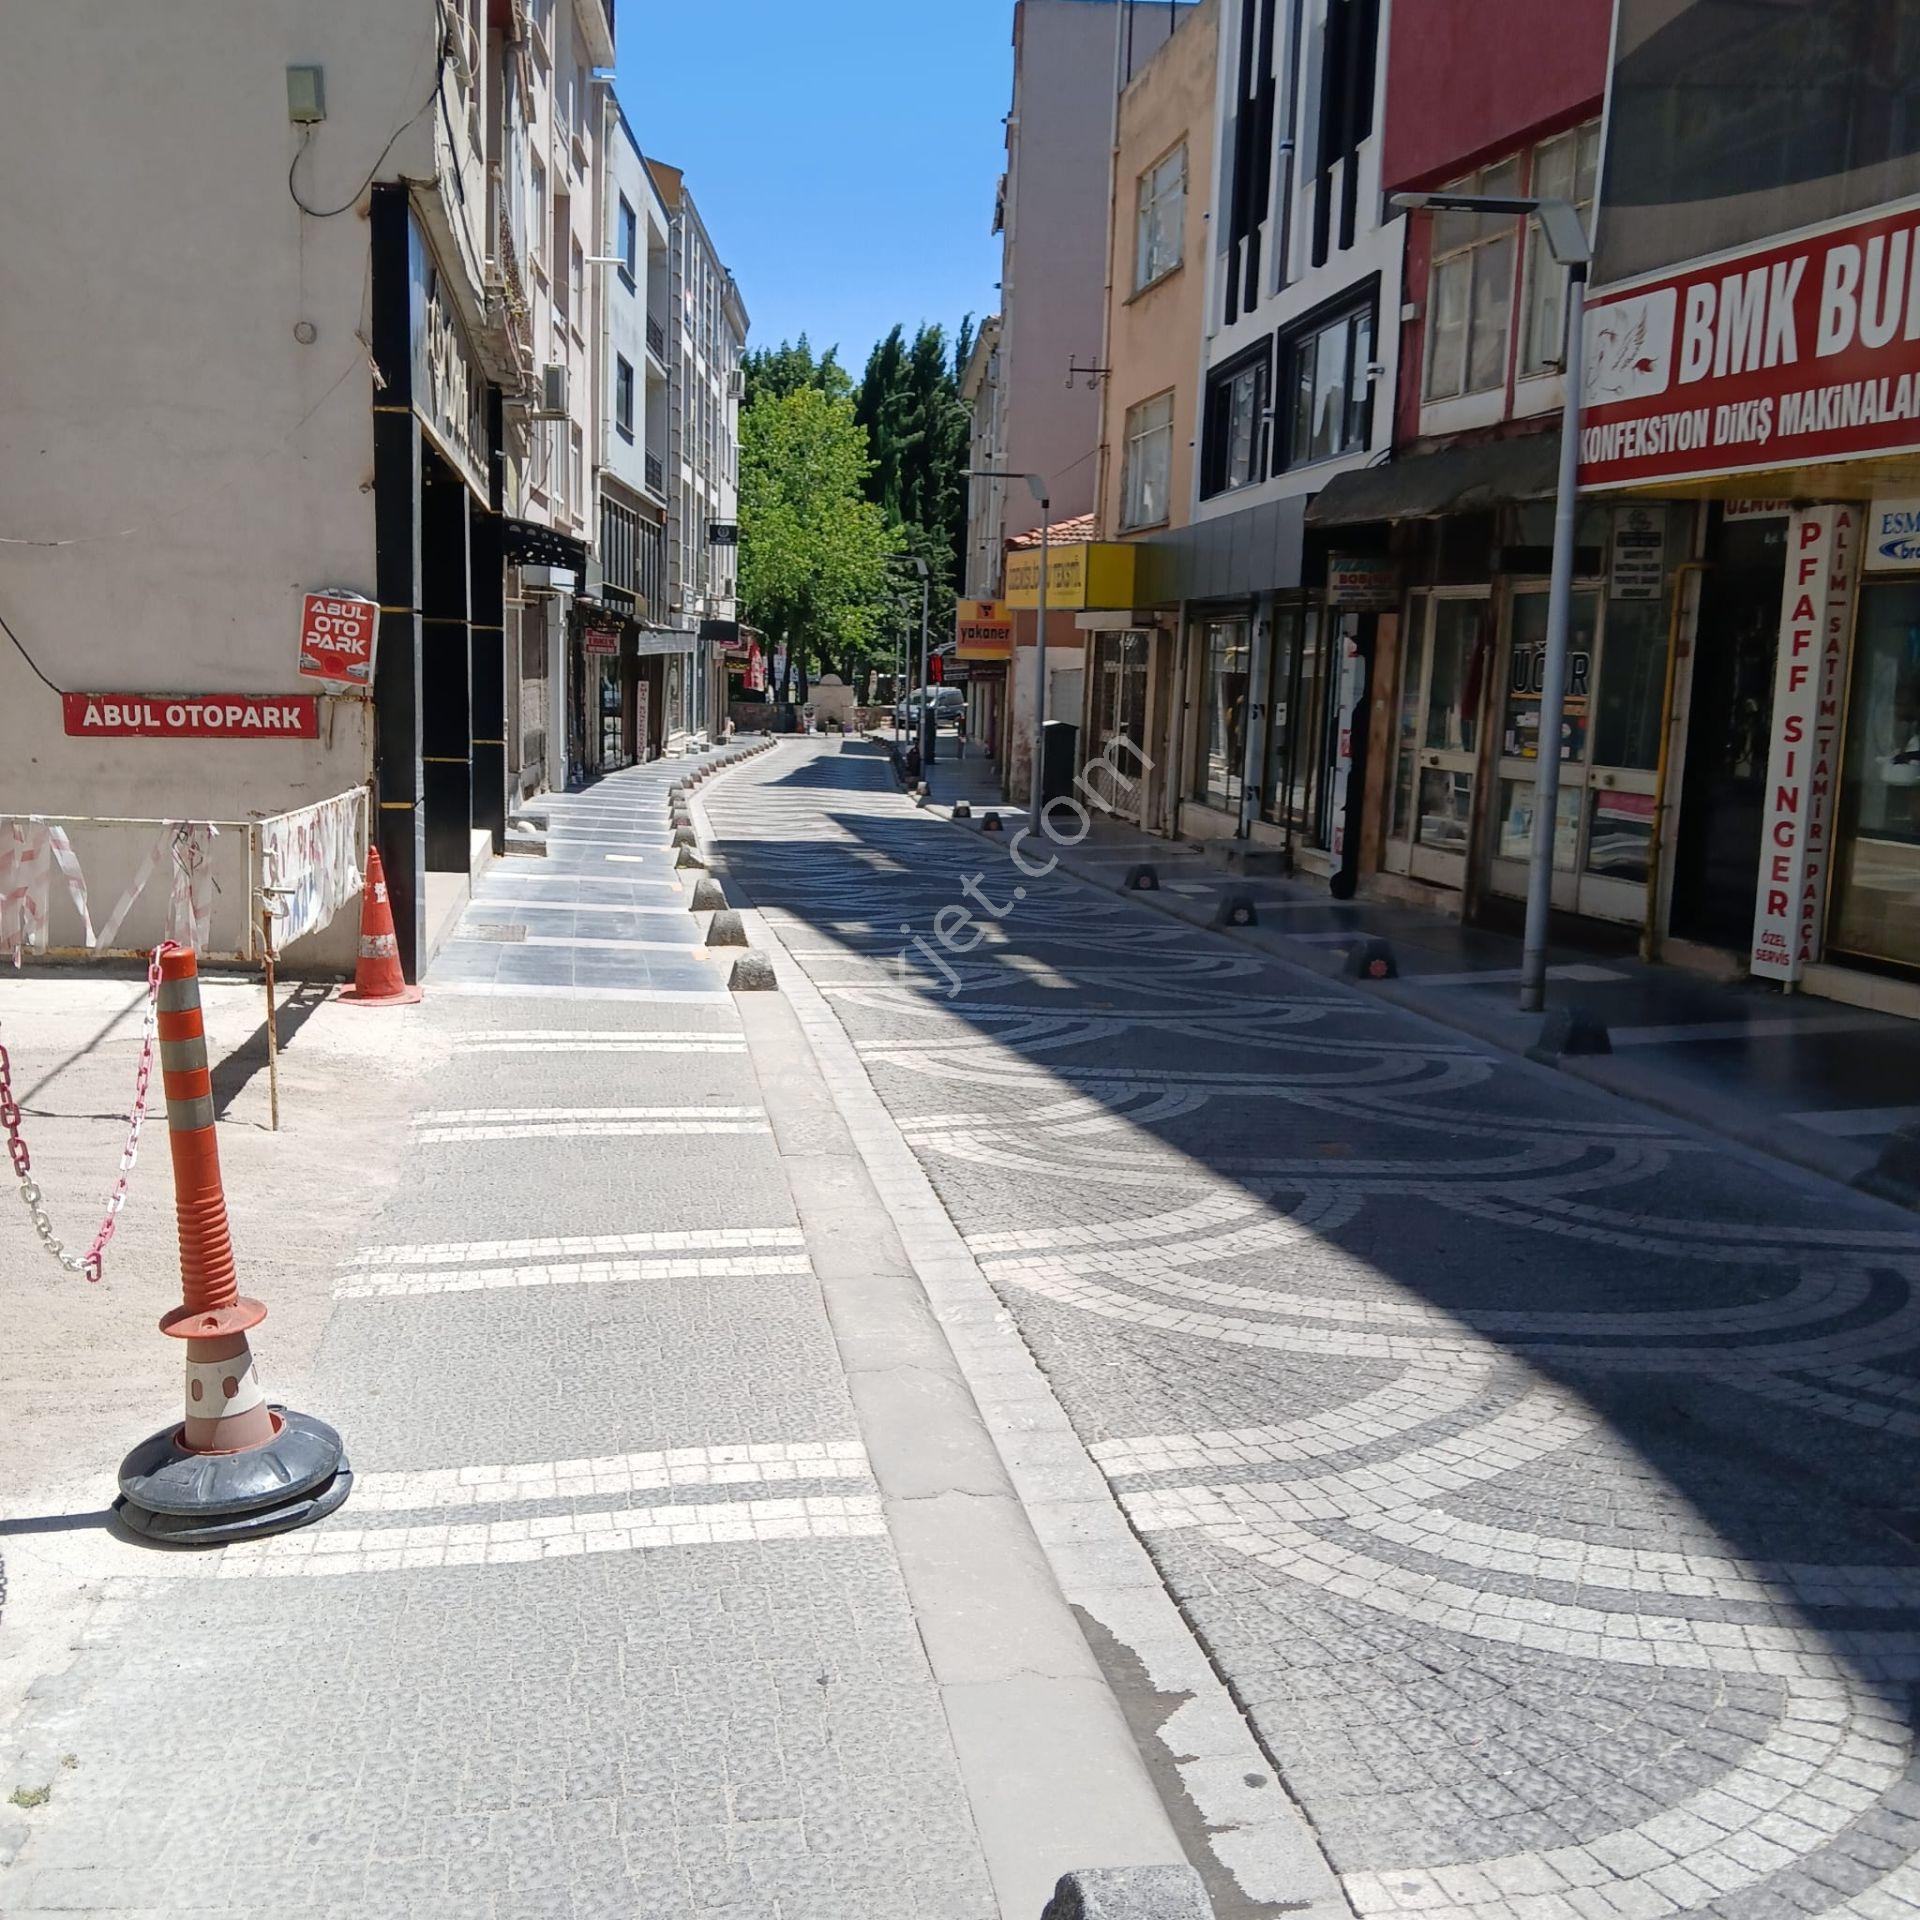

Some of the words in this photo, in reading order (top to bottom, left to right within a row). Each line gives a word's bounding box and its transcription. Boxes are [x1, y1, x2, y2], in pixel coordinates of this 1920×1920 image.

[1678, 255, 1809, 385] BMK
[1579, 408, 1710, 465] KONFEKSİYON
[1713, 396, 1772, 446] DİKİŞ
[1777, 372, 1920, 437] MAKİNALA
[310, 600, 368, 621] ABUL
[1789, 521, 1822, 693] PFAFF
[314, 616, 360, 638] OTO
[960, 624, 1010, 644] yakaner
[305, 631, 367, 656] PARK
[1513, 640, 1590, 695] UĞR
[82, 704, 161, 727] ABUL
[165, 704, 303, 729] OTOPARK
[1766, 715, 1804, 918] SINGER
[1761, 929, 1787, 948] ÖZEL
[1755, 948, 1790, 966] SERVİS
